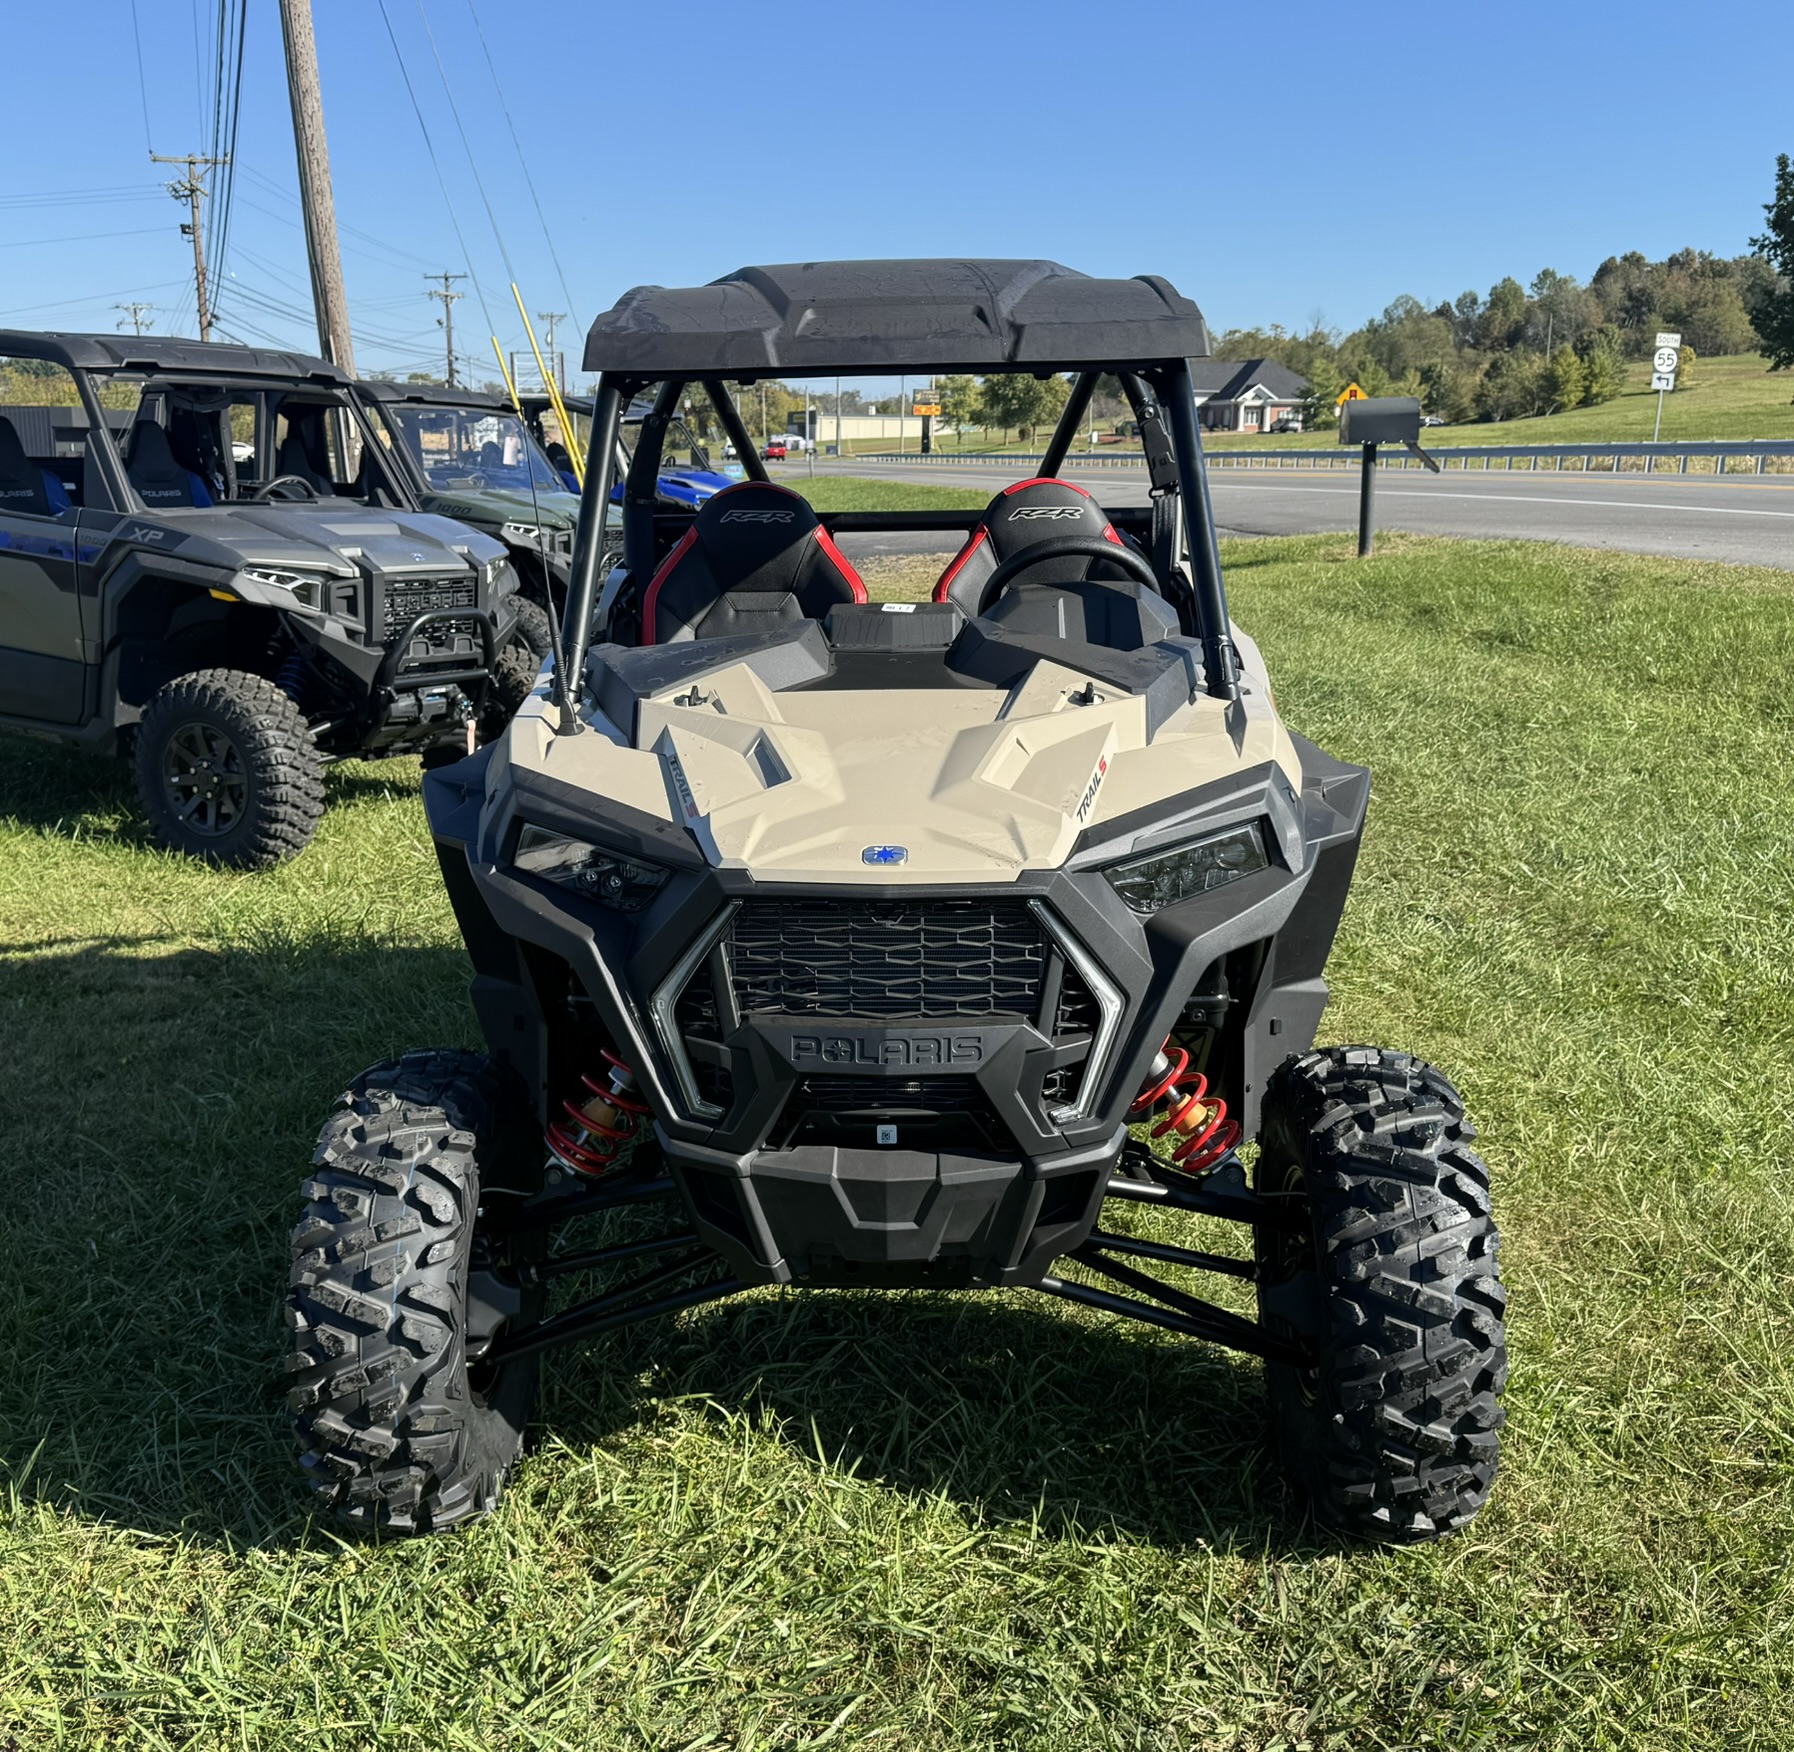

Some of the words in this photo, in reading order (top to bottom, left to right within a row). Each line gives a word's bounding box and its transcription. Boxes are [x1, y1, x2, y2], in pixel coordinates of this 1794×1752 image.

[1657, 335, 1679, 345] SOUTH
[1657, 353, 1675, 367] 55
[0, 489, 34, 498] OLARIS
[141, 489, 182, 498] POLARIS
[437, 503, 472, 515] 1000
[1008, 506, 1085, 521] RZR
[719, 509, 796, 524] RZR
[80, 534, 108, 547] 1000
[128, 527, 165, 543] XP
[393, 592, 471, 610] POLARIS
[790, 1034, 983, 1065] POLARIS
